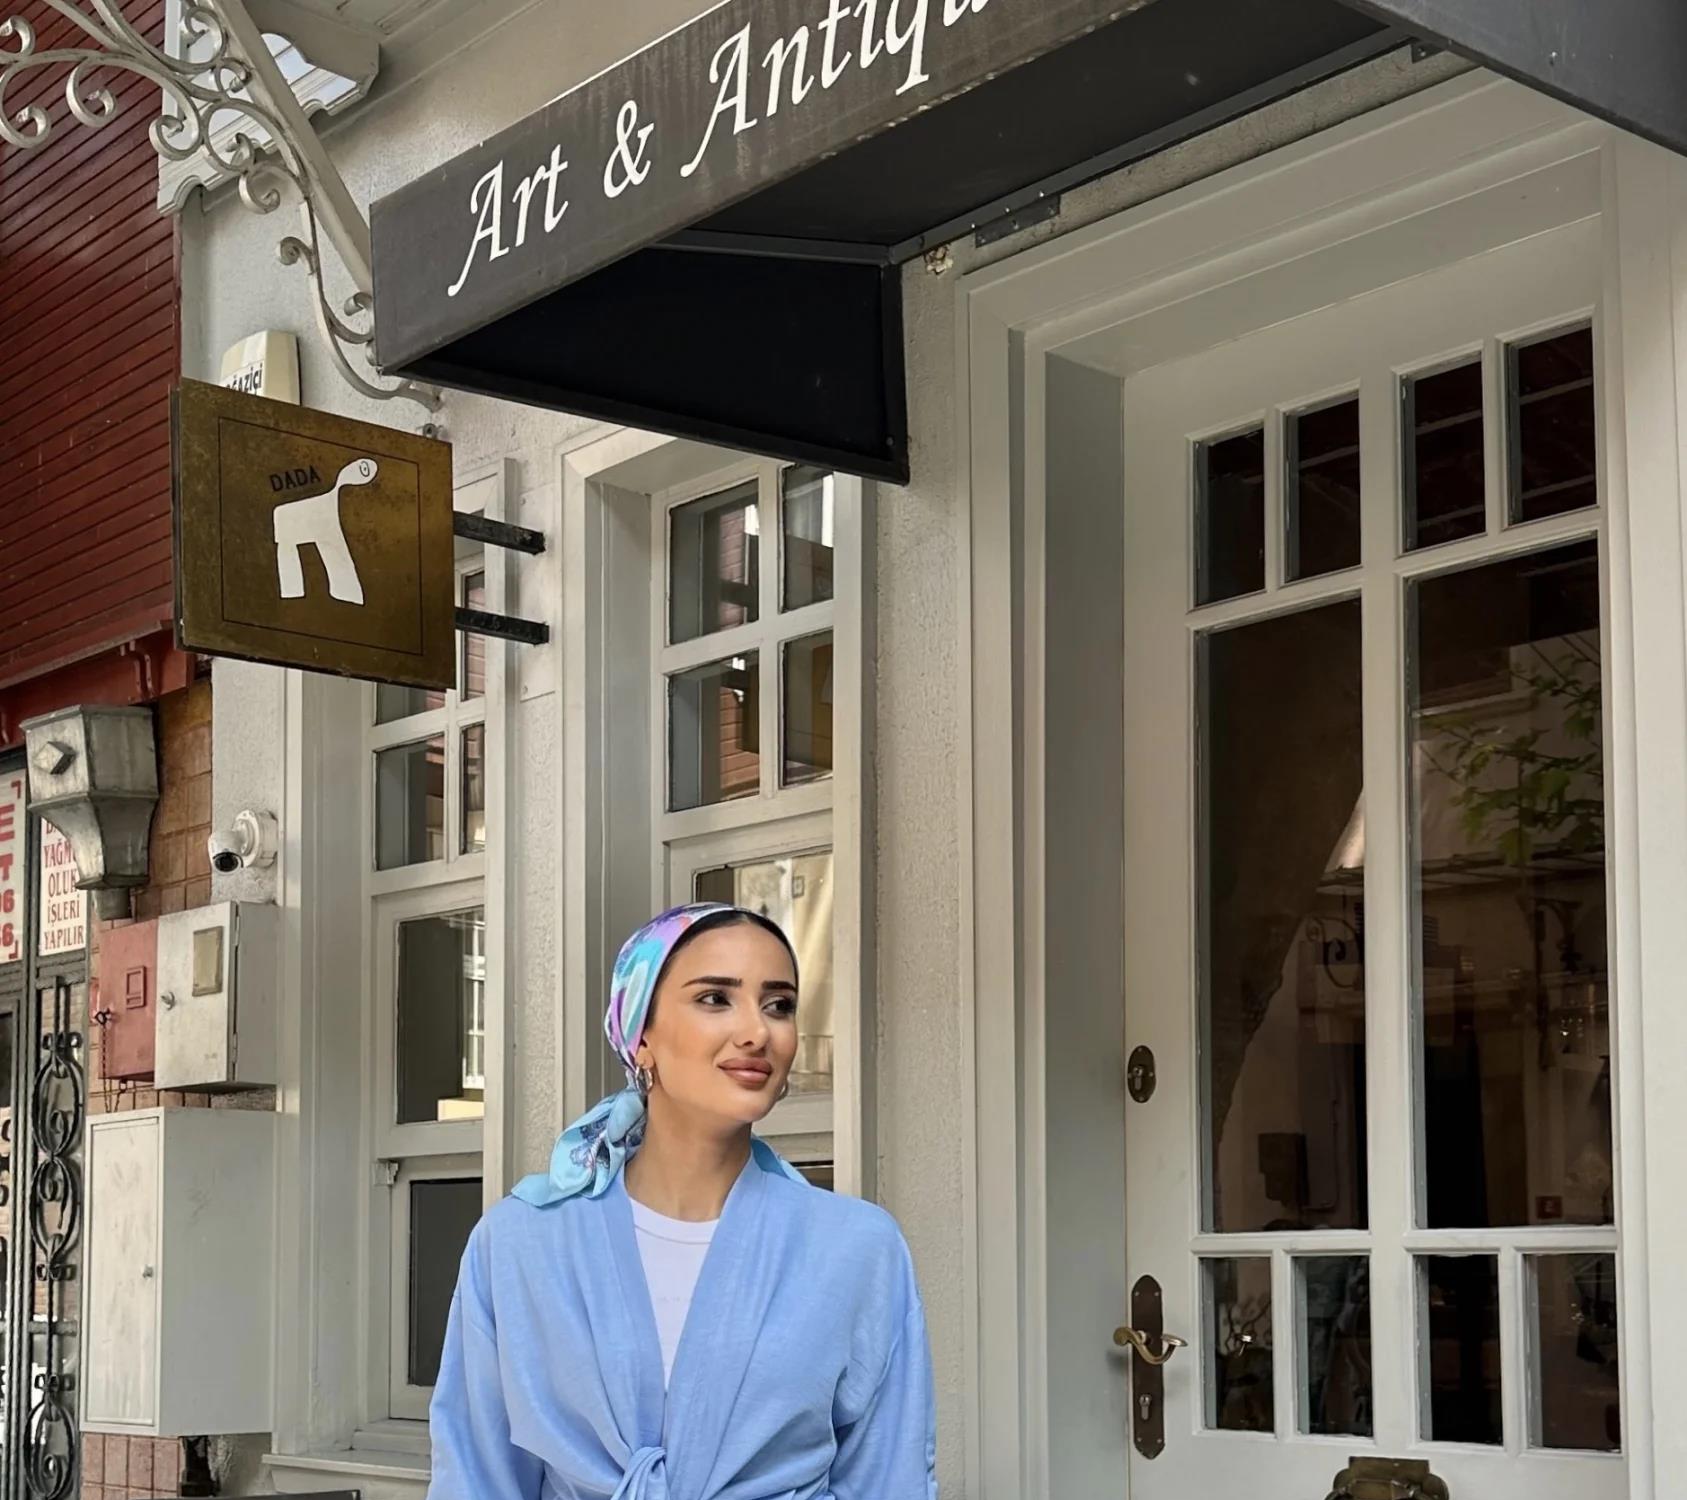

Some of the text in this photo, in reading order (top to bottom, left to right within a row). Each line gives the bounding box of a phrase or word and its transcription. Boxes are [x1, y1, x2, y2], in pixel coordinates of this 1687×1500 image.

[447, 143, 569, 297] Art
[602, 99, 654, 199] &
[269, 465, 321, 492] DADA
[47, 893, 80, 927] İŞLERİ
[44, 925, 84, 950] YAPILIR
